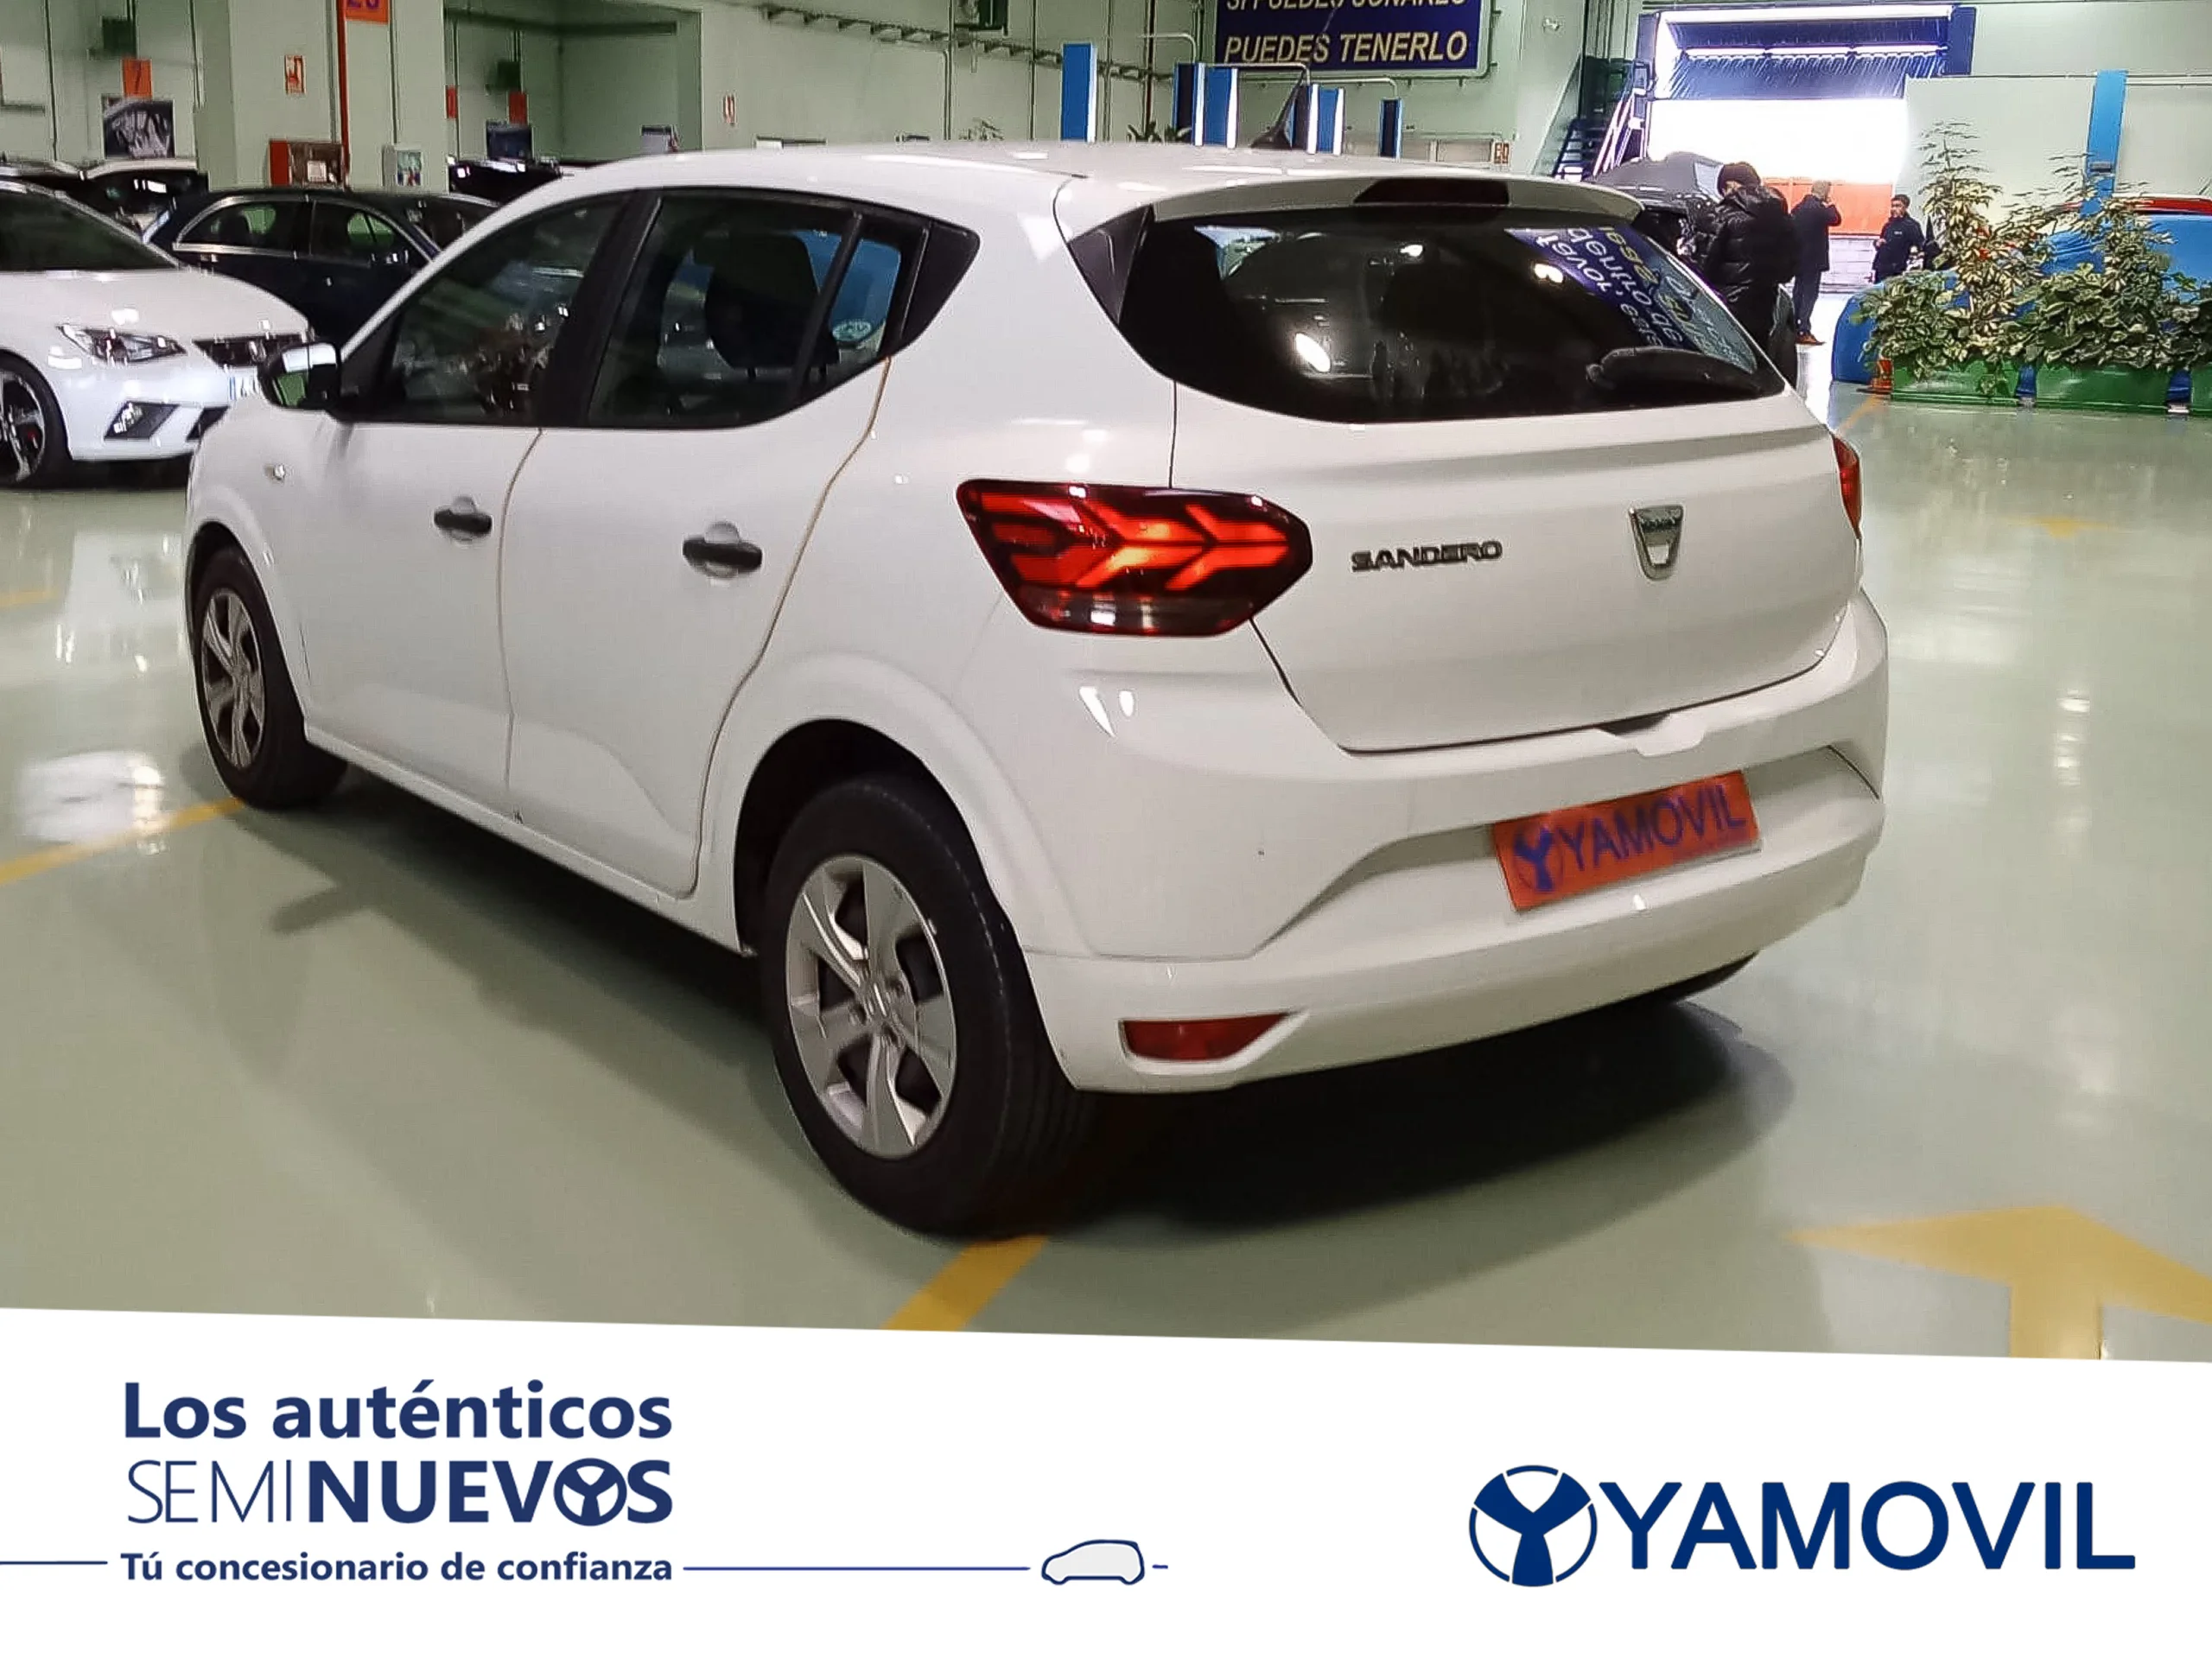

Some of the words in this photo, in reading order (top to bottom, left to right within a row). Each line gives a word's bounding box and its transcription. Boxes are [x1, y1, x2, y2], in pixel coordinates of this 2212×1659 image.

[1224, 33, 1331, 63] PUEDES
[1340, 30, 1468, 63] TENERLO
[1351, 540, 1503, 573] SANDERO
[1558, 784, 1747, 872] YAMOVIL
